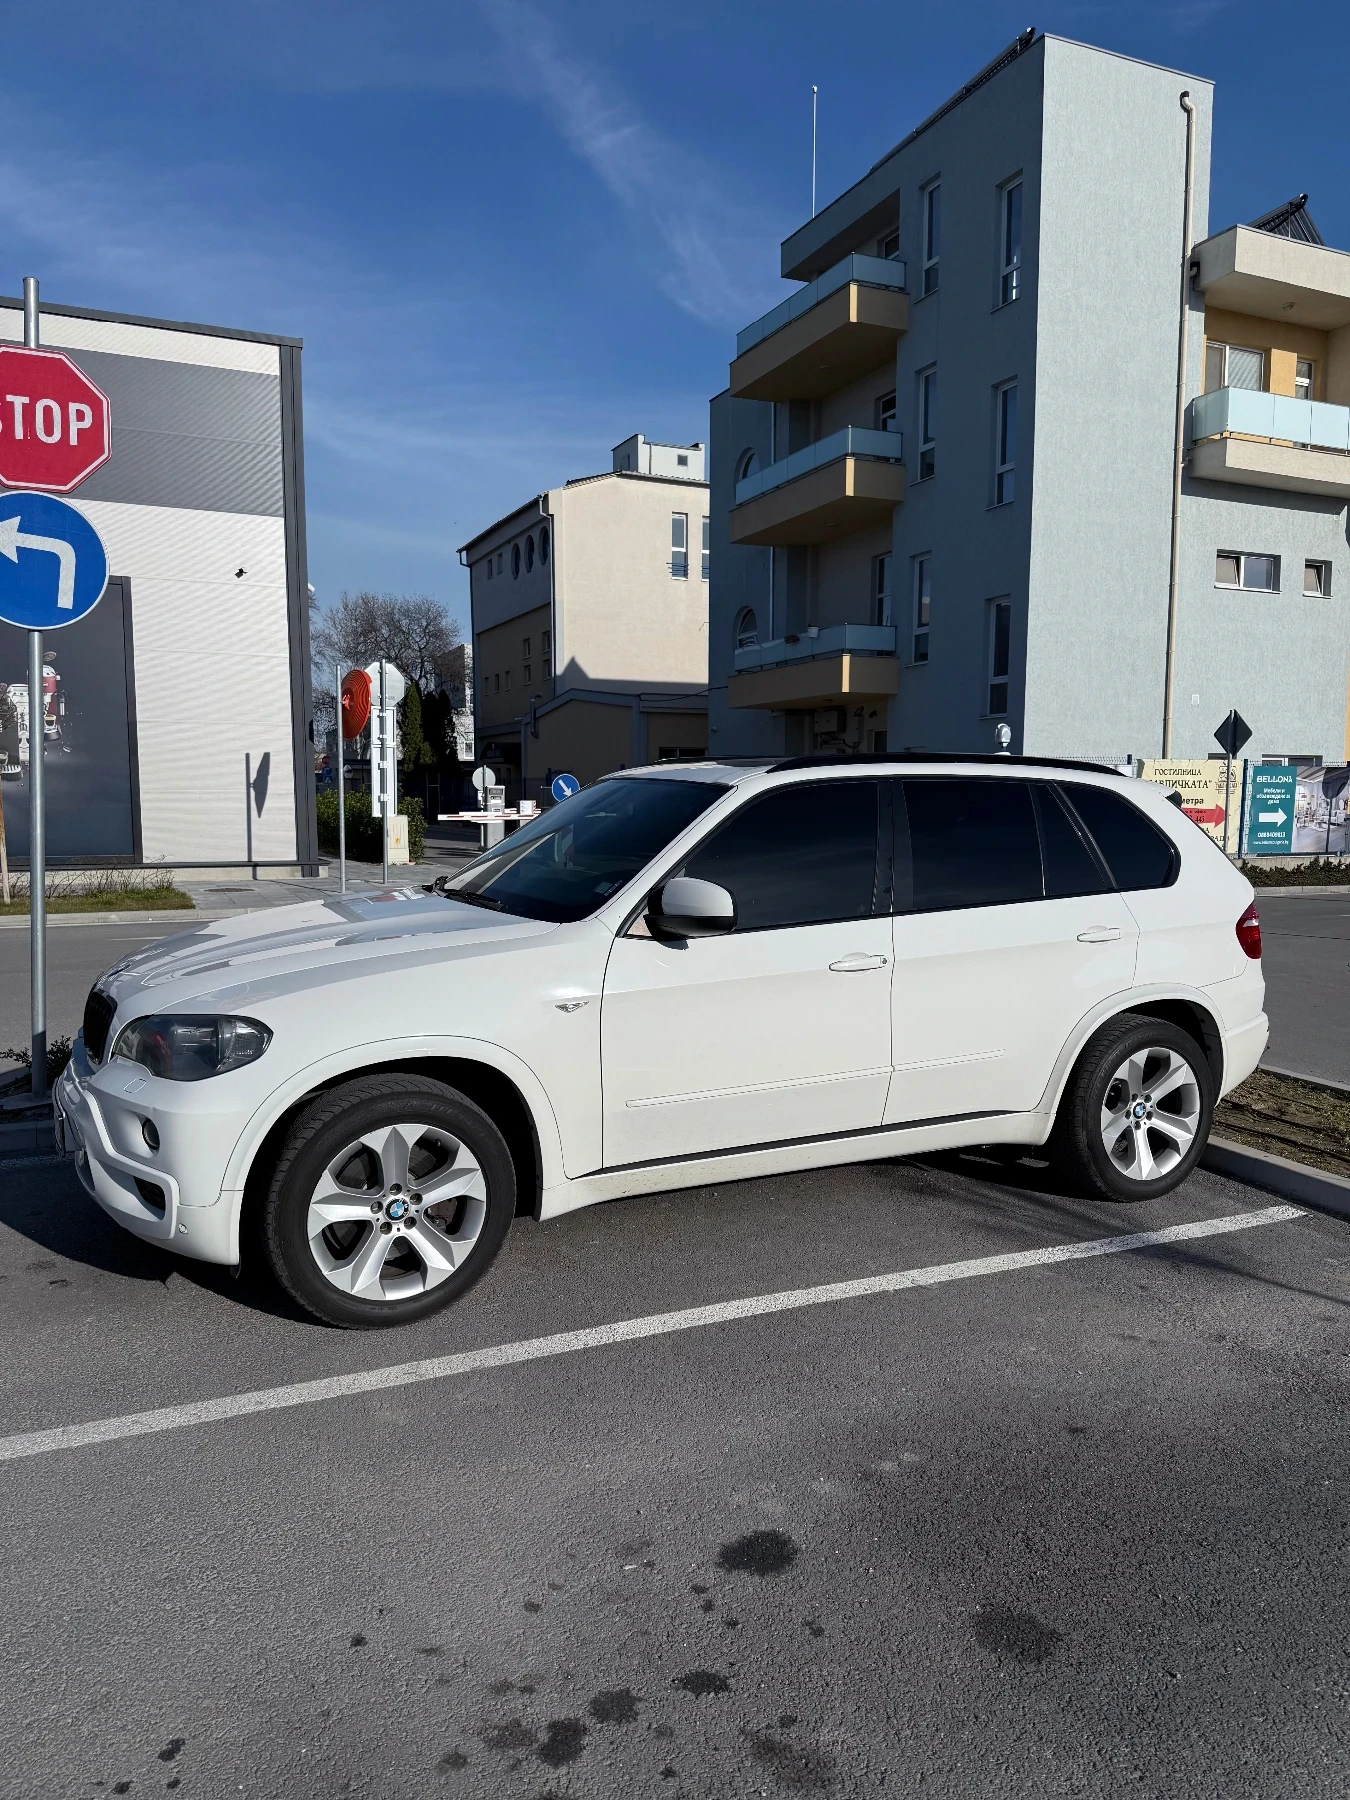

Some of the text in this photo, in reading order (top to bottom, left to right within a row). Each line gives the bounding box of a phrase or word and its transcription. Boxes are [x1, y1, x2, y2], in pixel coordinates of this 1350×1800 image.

[0, 394, 93, 446] TOP
[1154, 768, 1202, 776] ГОСТИЛНИЦА
[1256, 775, 1293, 783] BELLONA
